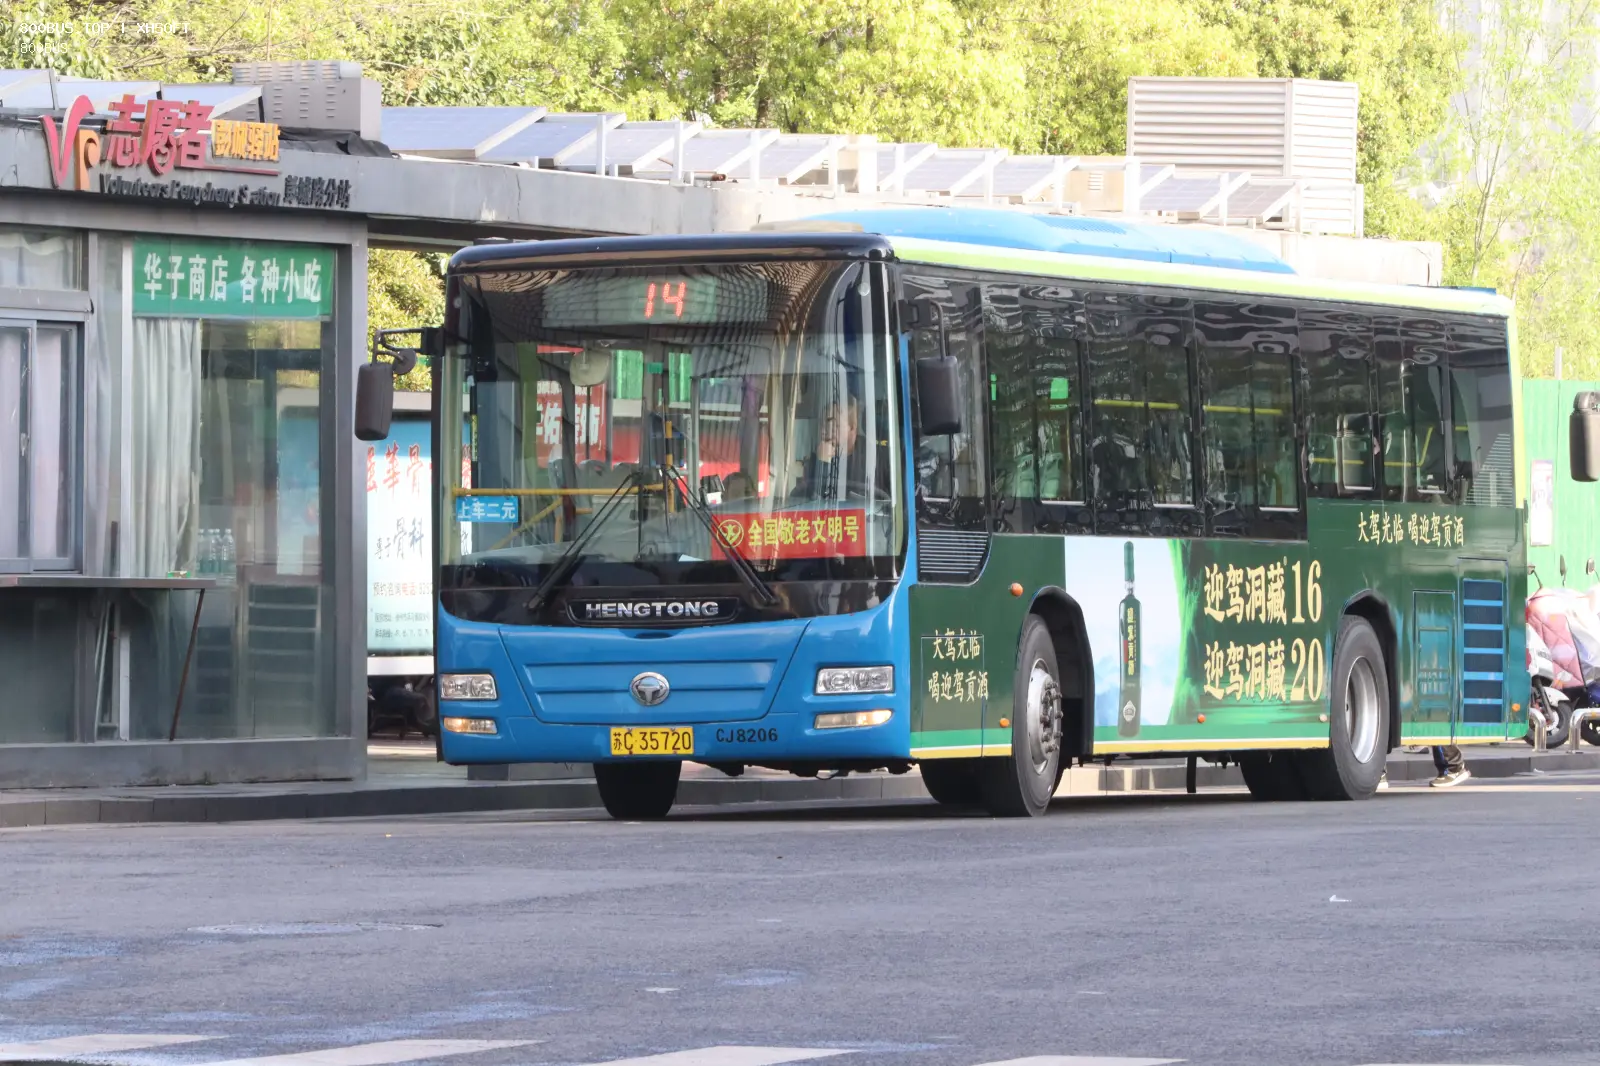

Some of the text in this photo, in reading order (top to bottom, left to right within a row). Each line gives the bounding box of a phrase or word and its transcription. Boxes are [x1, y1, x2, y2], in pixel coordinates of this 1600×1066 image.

[106, 94, 215, 175] 志愿者
[238, 185, 280, 206] Sation
[144, 252, 321, 304] 华子商店 各种小吃
[645, 282, 686, 318] 14
[458, 499, 516, 520] 上车二元
[748, 516, 860, 547] 全国敬老文明号
[1358, 510, 1464, 547] 大驾光临 喝迎驾贡酒
[585, 600, 719, 619] HENGTONG
[933, 628, 980, 662] 大驾光临
[928, 668, 989, 703] 喝迎驾贡酒
[716, 728, 778, 743] CJ8206
